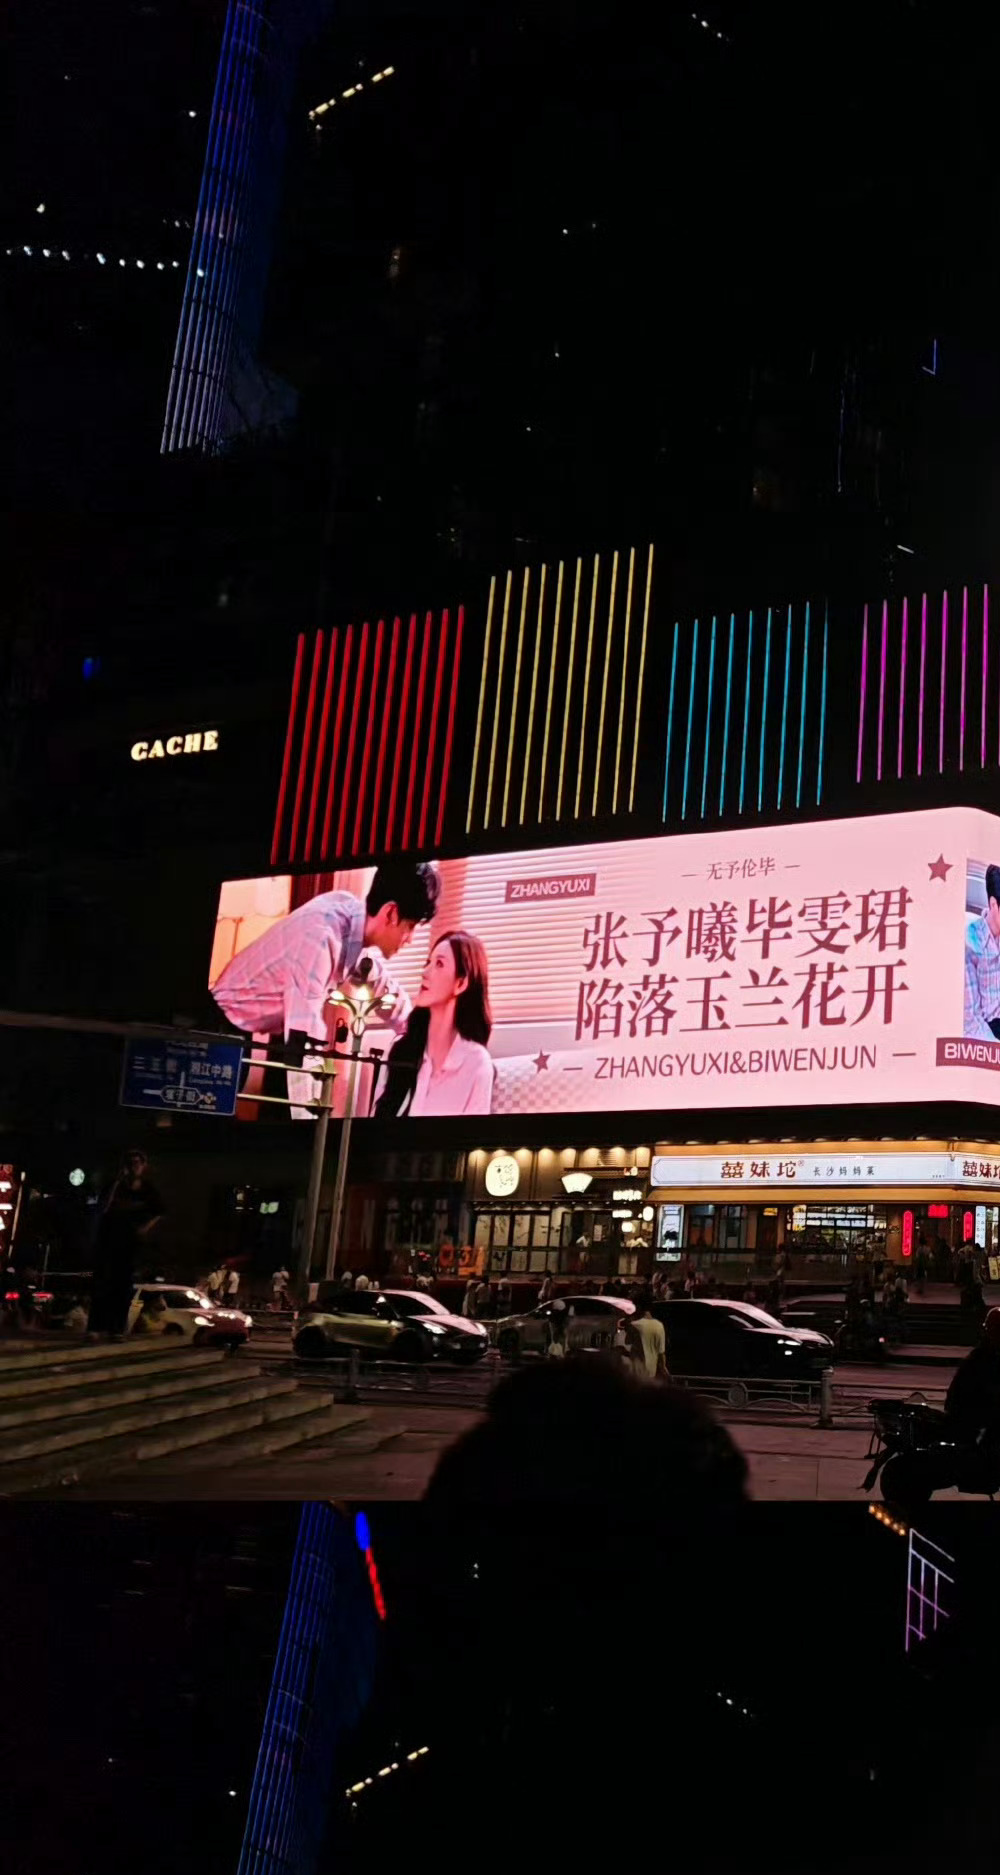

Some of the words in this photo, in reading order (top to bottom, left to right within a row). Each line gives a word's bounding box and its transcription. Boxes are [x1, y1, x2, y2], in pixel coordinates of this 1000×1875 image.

[130, 729, 219, 762] CACHE
[707, 857, 776, 881] 无予伦毕
[511, 878, 590, 899] ZHANGYUXI
[581, 886, 914, 973] 张予曦毕雯珺
[574, 960, 910, 1041] 陷落玉兰花开
[595, 1045, 877, 1080] ZHANGYUXI&BIWENJUN
